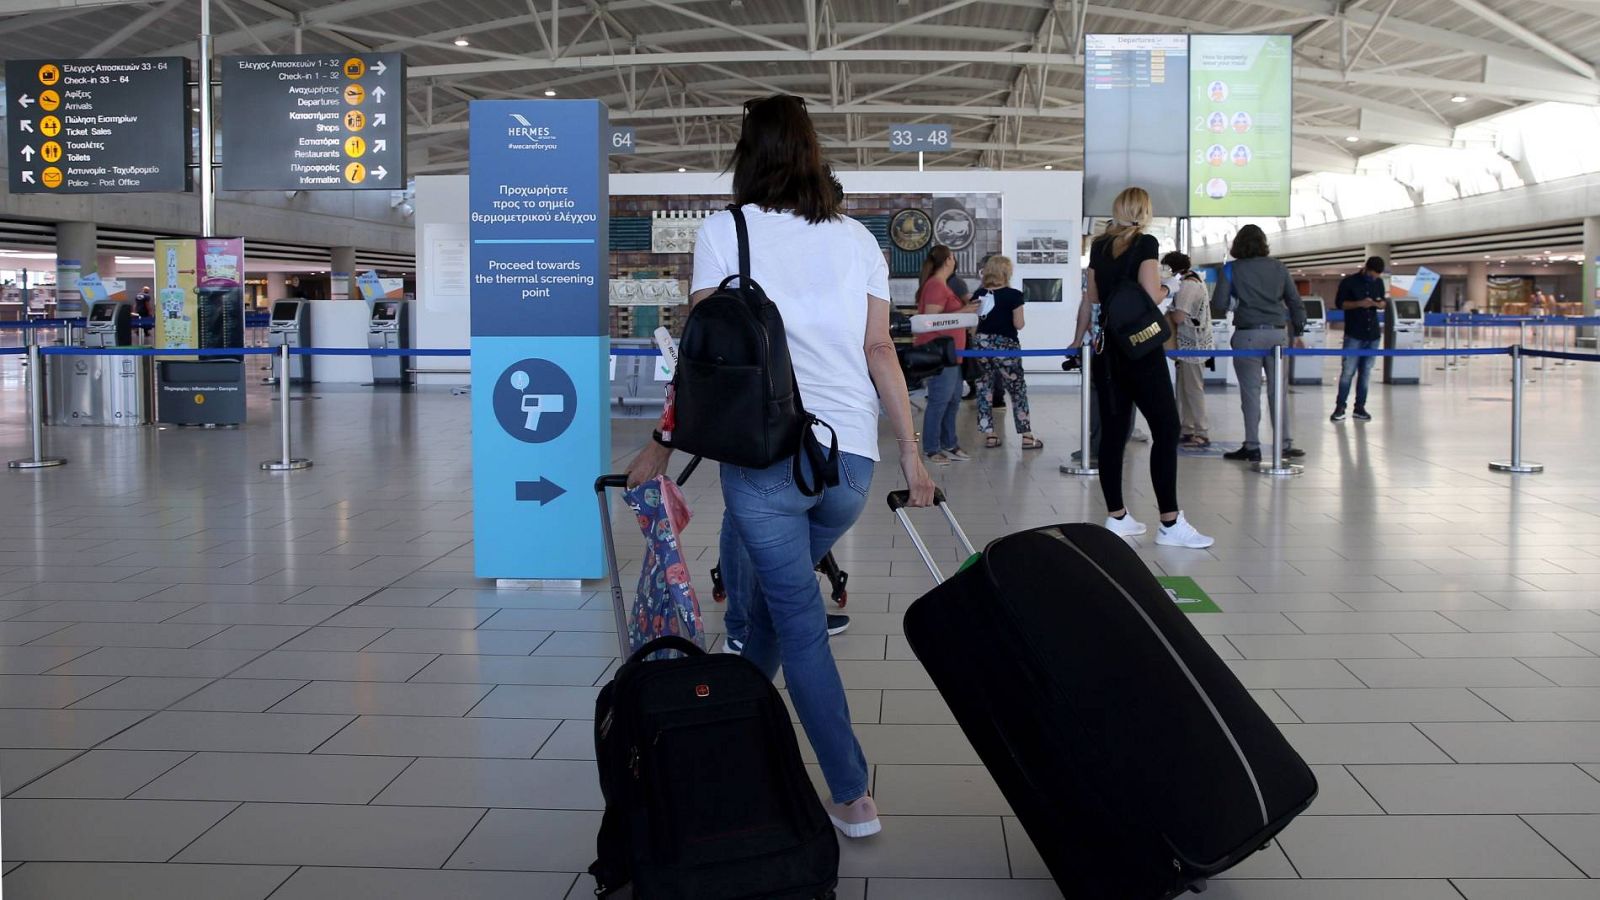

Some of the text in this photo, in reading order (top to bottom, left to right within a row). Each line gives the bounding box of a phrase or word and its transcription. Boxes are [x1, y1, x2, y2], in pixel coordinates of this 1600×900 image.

[63, 64, 95, 74] Έλεγχος
[96, 64, 139, 72] Αποσκευών
[158, 62, 168, 70] 64
[237, 61, 270, 70] Έλεγχος
[64, 76, 98, 84] Check-in
[100, 76, 110, 84] 33
[119, 75, 129, 83] 64
[279, 72, 312, 81] Check-in
[289, 86, 339, 94] Αναχωρήσεις
[64, 90, 92, 100] Αφίξεις
[65, 102, 93, 110] Arrivals
[297, 98, 340, 107] Departures
[65, 115, 138, 125] Πώληση Εισιτηρίων
[289, 112, 340, 120] Καταστήματα
[66, 127, 112, 136] Ticket Sales
[316, 124, 340, 133] Shops
[508, 127, 550, 138] HERMES
[612, 132, 632, 147] 64
[892, 130, 913, 145] 33
[927, 130, 948, 145] 48
[66, 141, 104, 150] Τουαλέτες
[299, 138, 340, 147] Εστιατόρια
[508, 143, 557, 151] #wecareforyou
[67, 154, 91, 162] Toilets
[294, 150, 340, 158] Restaurants
[67, 166, 106, 175] Αστυνομία
[113, 166, 159, 175] Ταχυδρομείο
[291, 164, 340, 173] Πληροφορίες
[68, 179, 89, 187] Police
[118, 178, 140, 186] Office
[300, 176, 341, 184] Information
[499, 185, 568, 197] Προχωρήστε
[493, 199, 575, 210] προς το σημείο
[472, 212, 597, 224] θερμομετρικού ελέγχου
[489, 260, 581, 270] Proceed towards
[475, 274, 594, 286] the thermal screening
[522, 287, 550, 299] point
[932, 319, 959, 327] REUTERS
[1129, 321, 1162, 346] PUMA
